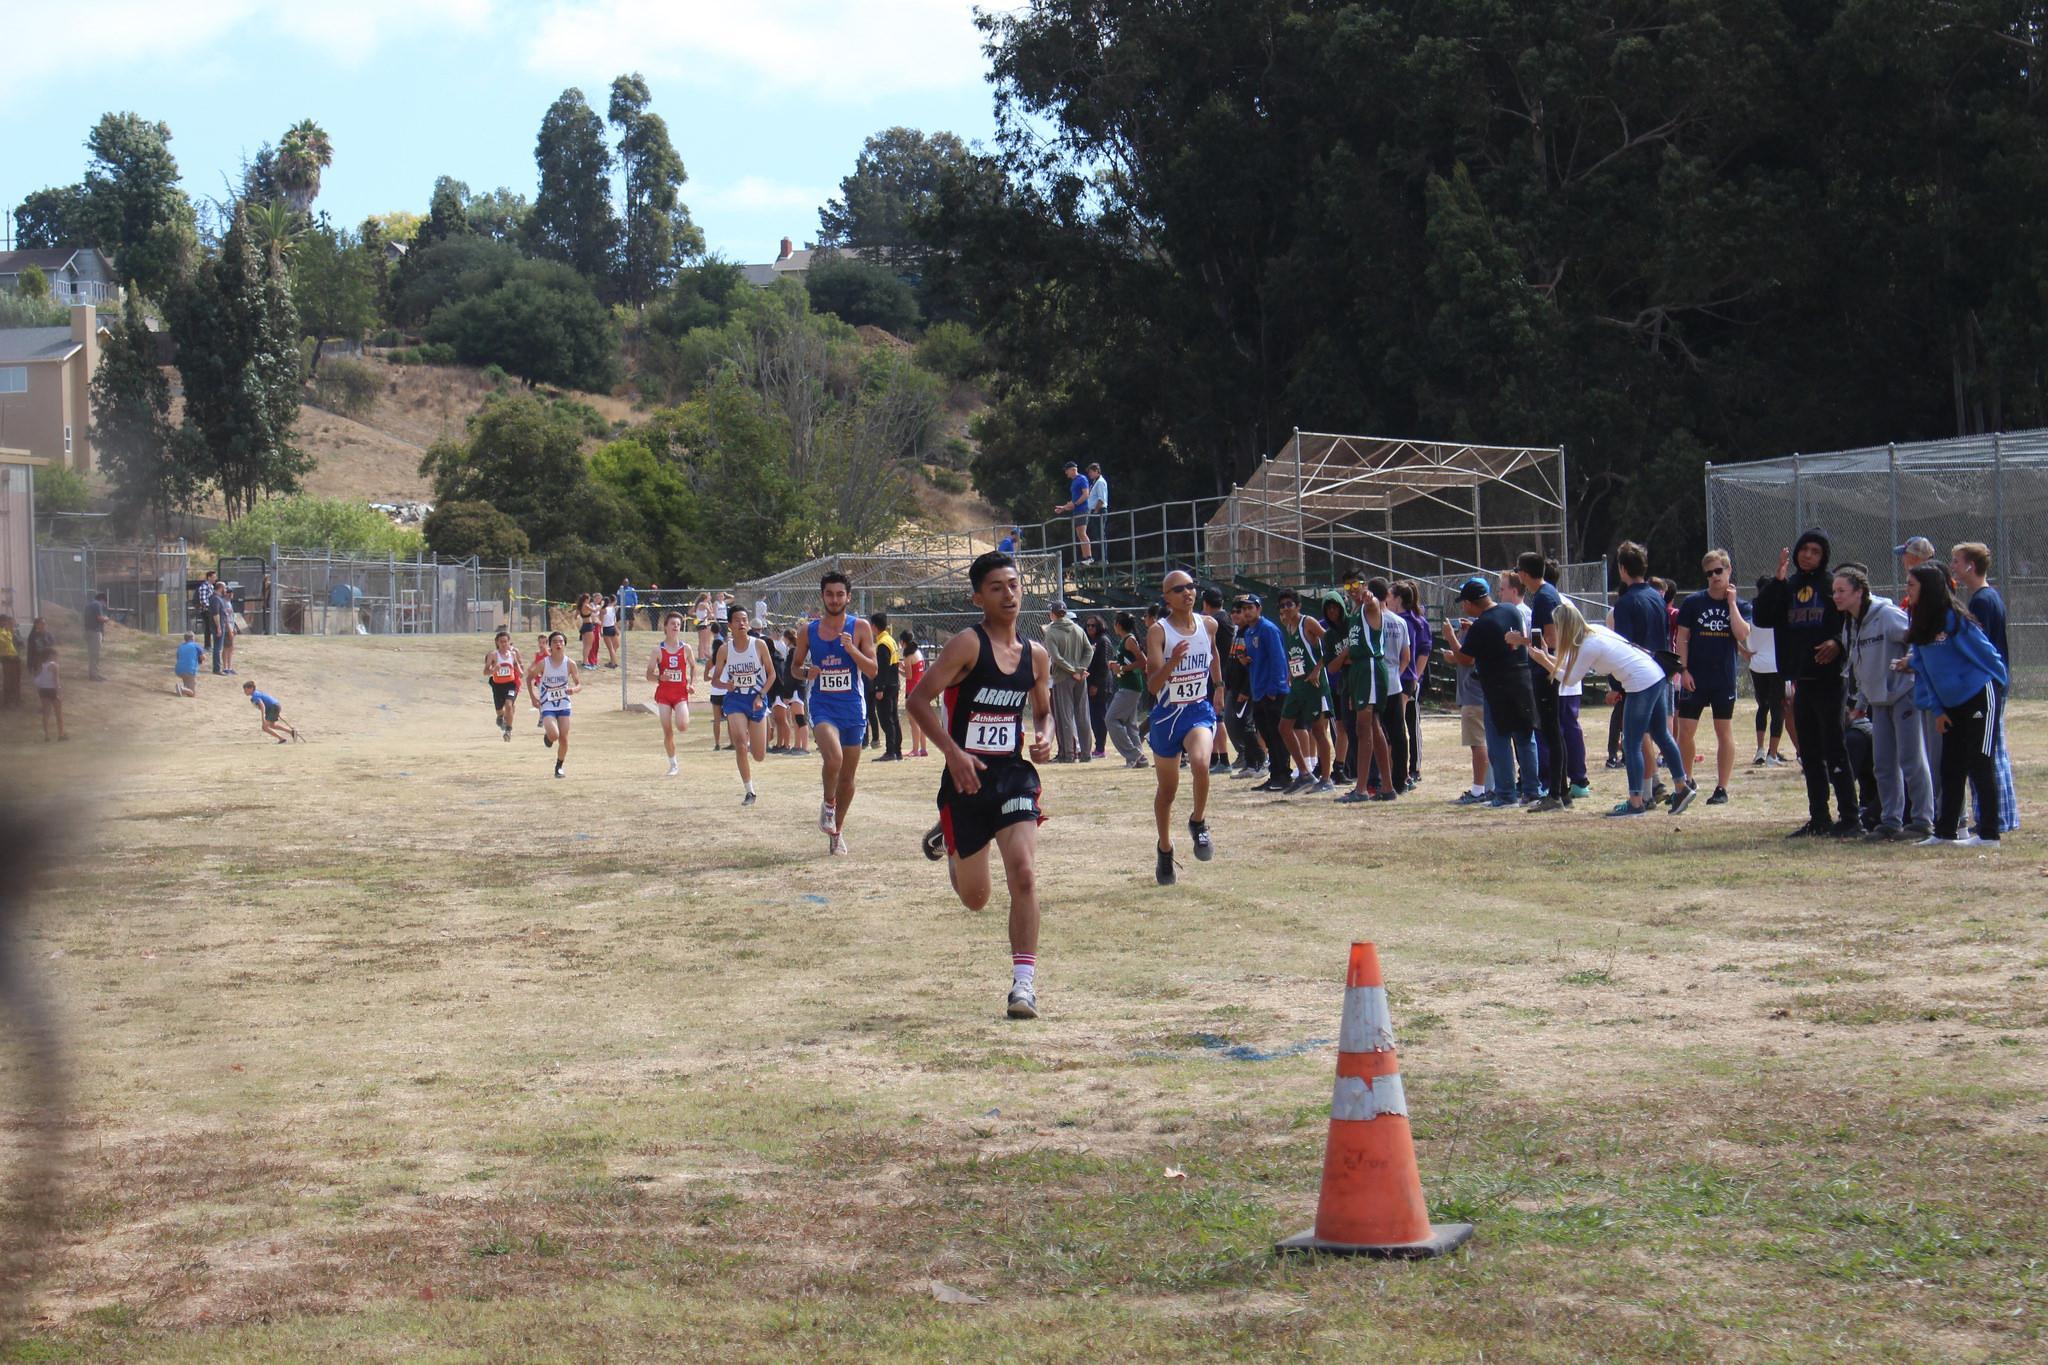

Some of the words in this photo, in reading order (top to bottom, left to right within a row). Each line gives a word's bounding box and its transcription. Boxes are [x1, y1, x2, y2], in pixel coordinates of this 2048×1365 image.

[1697, 608, 1731, 625] BENTL
[669, 655, 679, 668] S
[1165, 653, 1208, 672] CINAL
[736, 676, 752, 685] 429
[822, 675, 849, 688] 1564
[550, 689, 563, 698] 441
[1176, 682, 1202, 698] 437
[969, 713, 1015, 723] Athletic.net
[976, 725, 1008, 746] 126
